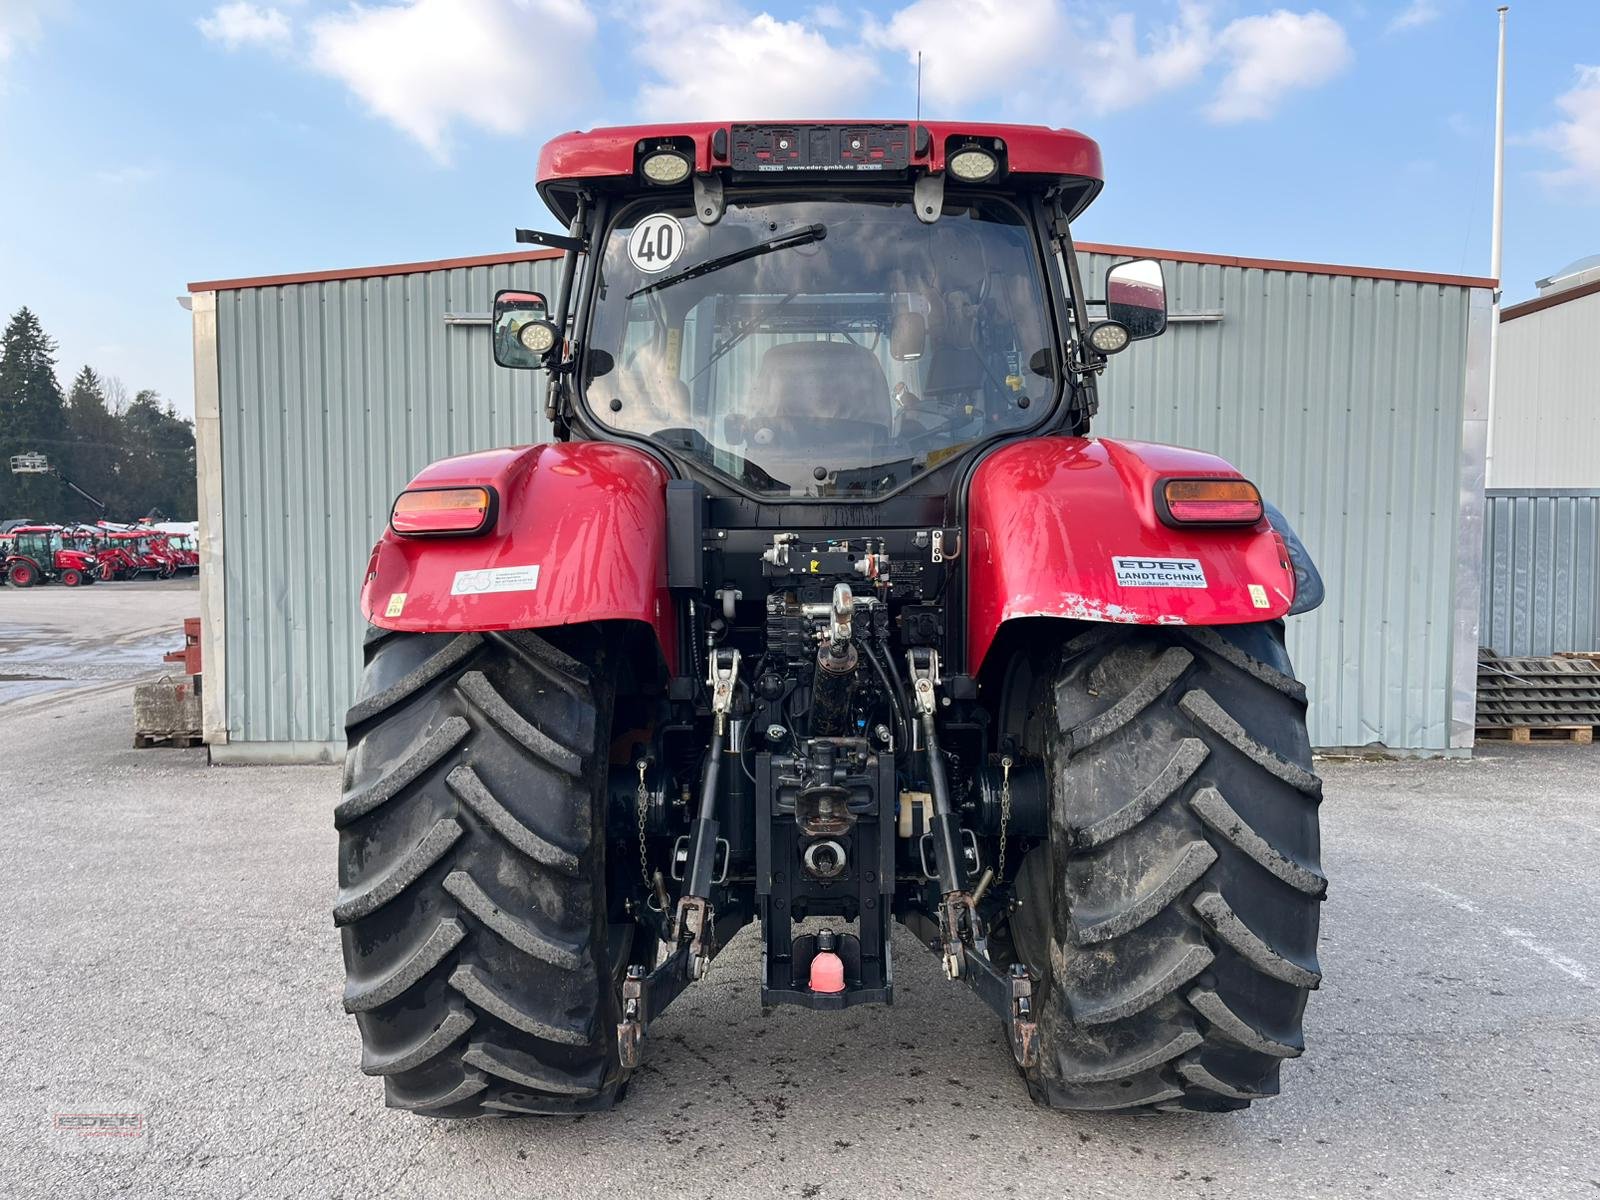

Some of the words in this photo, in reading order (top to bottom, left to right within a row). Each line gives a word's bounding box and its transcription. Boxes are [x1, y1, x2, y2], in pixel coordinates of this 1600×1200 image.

[637, 224, 673, 262] 40
[1118, 560, 1196, 571] EDER
[1117, 572, 1204, 581] LANDTECHNIK
